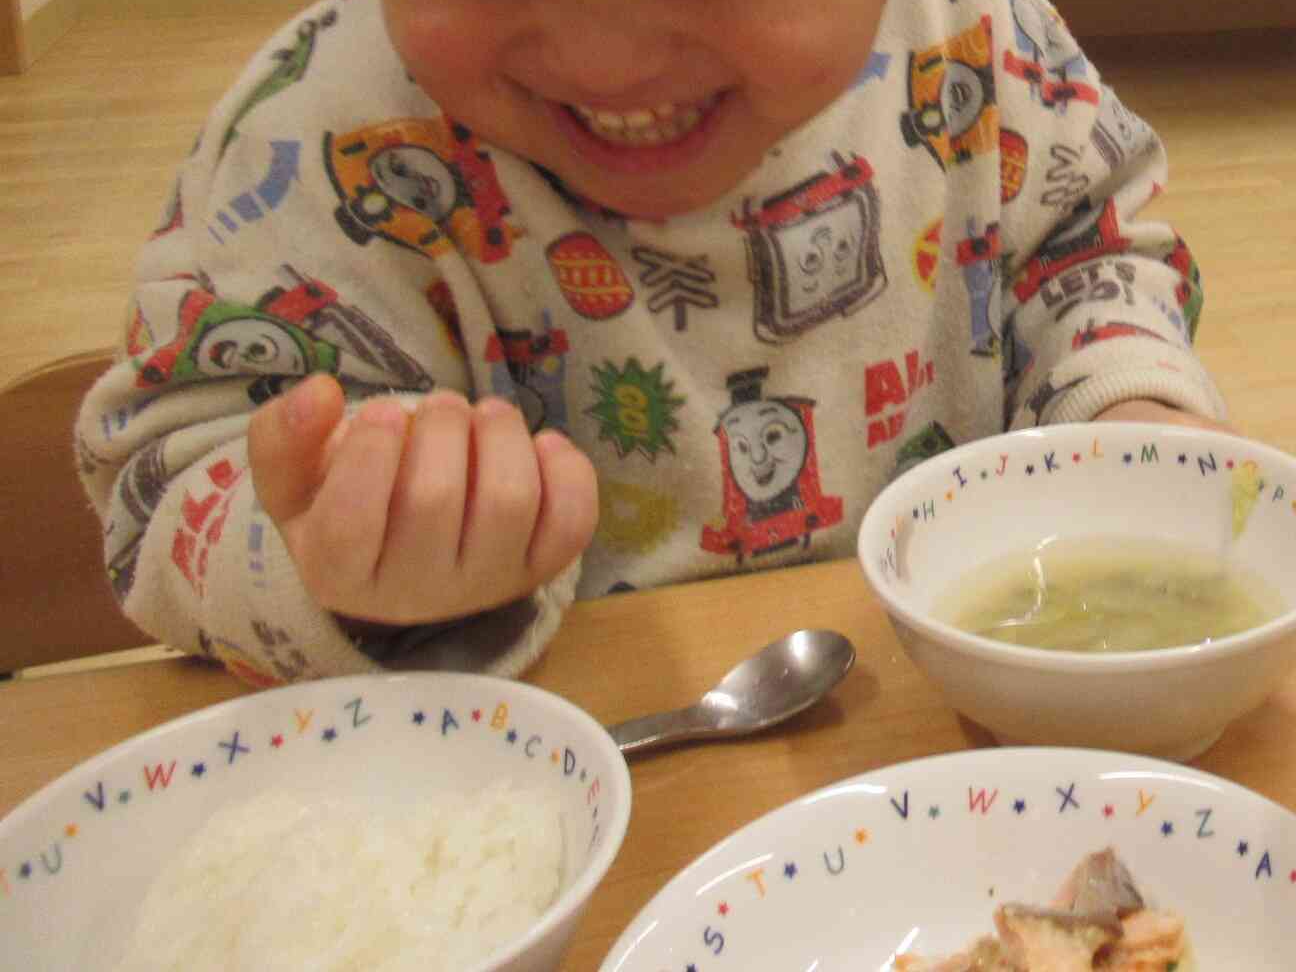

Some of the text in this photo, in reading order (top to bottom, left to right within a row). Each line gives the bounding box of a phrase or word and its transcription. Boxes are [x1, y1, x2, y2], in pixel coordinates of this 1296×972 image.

[923, 500, 936, 522] H
[952, 465, 968, 488] I
[995, 454, 1009, 477] J
[1044, 451, 1060, 473] K
[1091, 436, 1104, 459] L
[1140, 443, 1160, 464] M
[1197, 452, 1217, 476] N
[40, 842, 62, 874] U
[83, 780, 105, 812] V
[143, 759, 177, 791] W
[218, 730, 251, 765] X
[295, 708, 315, 734] Y
[344, 697, 373, 728] Z
[441, 708, 460, 736] A
[490, 701, 509, 732] B
[524, 734, 543, 759] C
[563, 747, 576, 776] D
[703, 925, 725, 956] S
[746, 868, 766, 900] T
[823, 844, 846, 876] U
[889, 790, 909, 821] V
[968, 785, 999, 816] W
[1055, 782, 1080, 814] X
[1135, 788, 1156, 818] Y
[1195, 808, 1216, 839] Z
[1255, 849, 1273, 879] A
